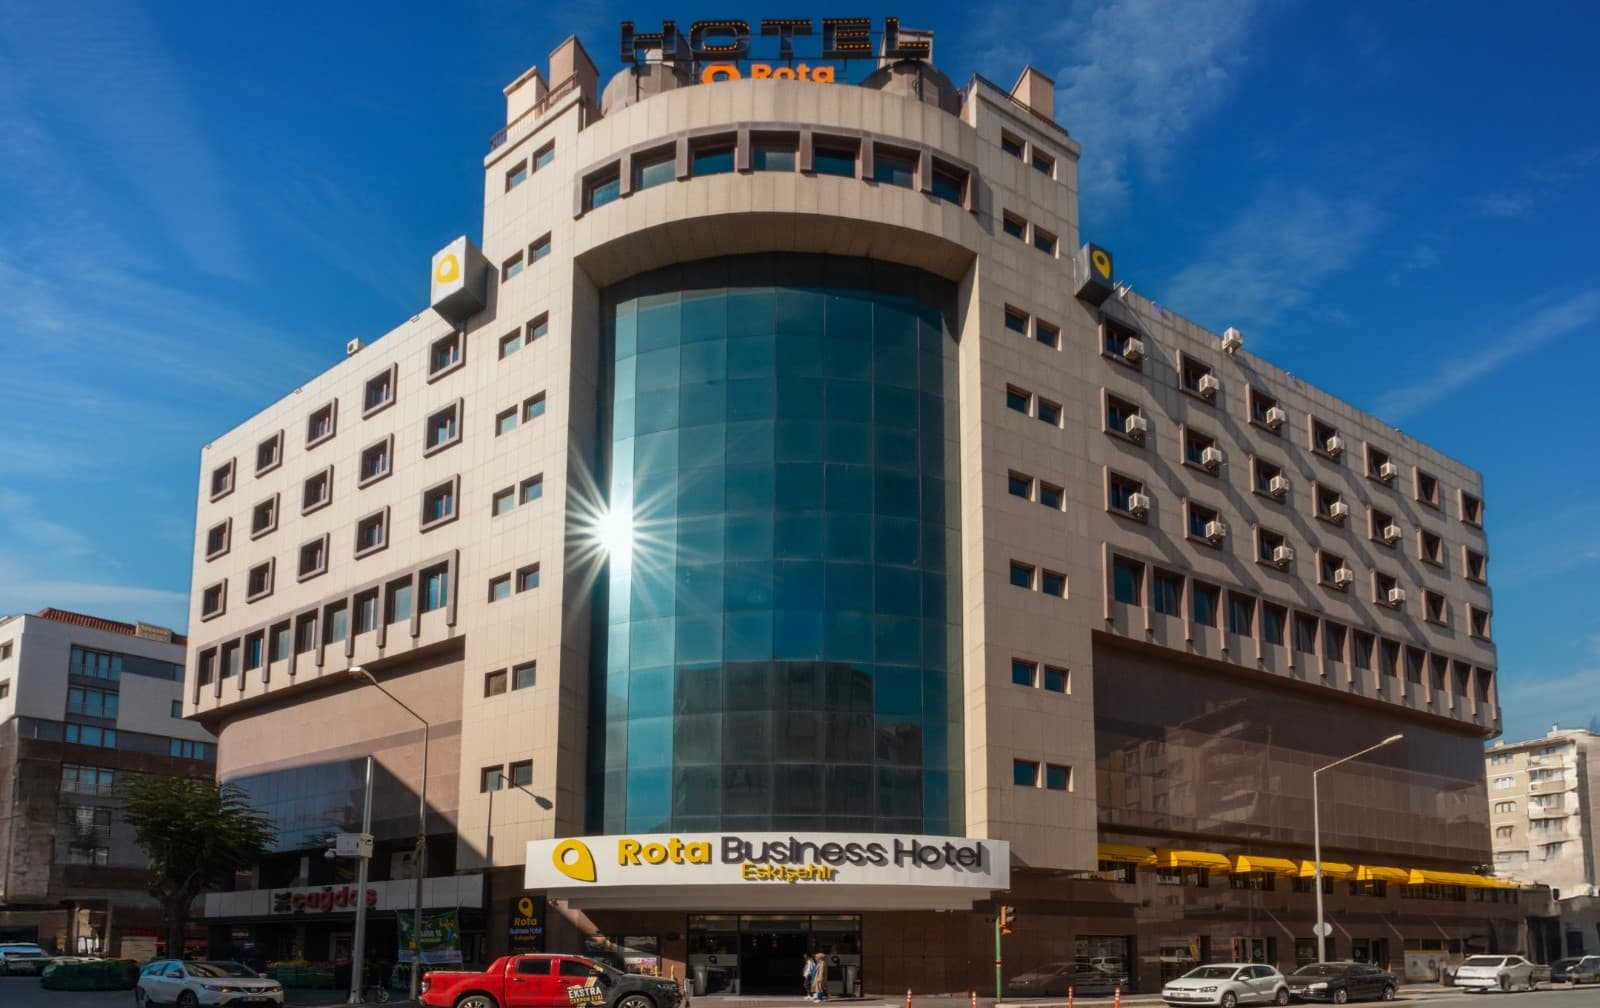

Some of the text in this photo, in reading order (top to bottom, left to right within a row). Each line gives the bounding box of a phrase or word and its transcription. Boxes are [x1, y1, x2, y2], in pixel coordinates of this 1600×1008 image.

[620, 16, 931, 61] HOTEL
[751, 63, 835, 84] Rota
[618, 834, 984, 869] Rota Business Hotel
[741, 862, 837, 884] Eskişehir
[513, 917, 537, 926] Rota
[568, 986, 602, 999] EKSTRA
